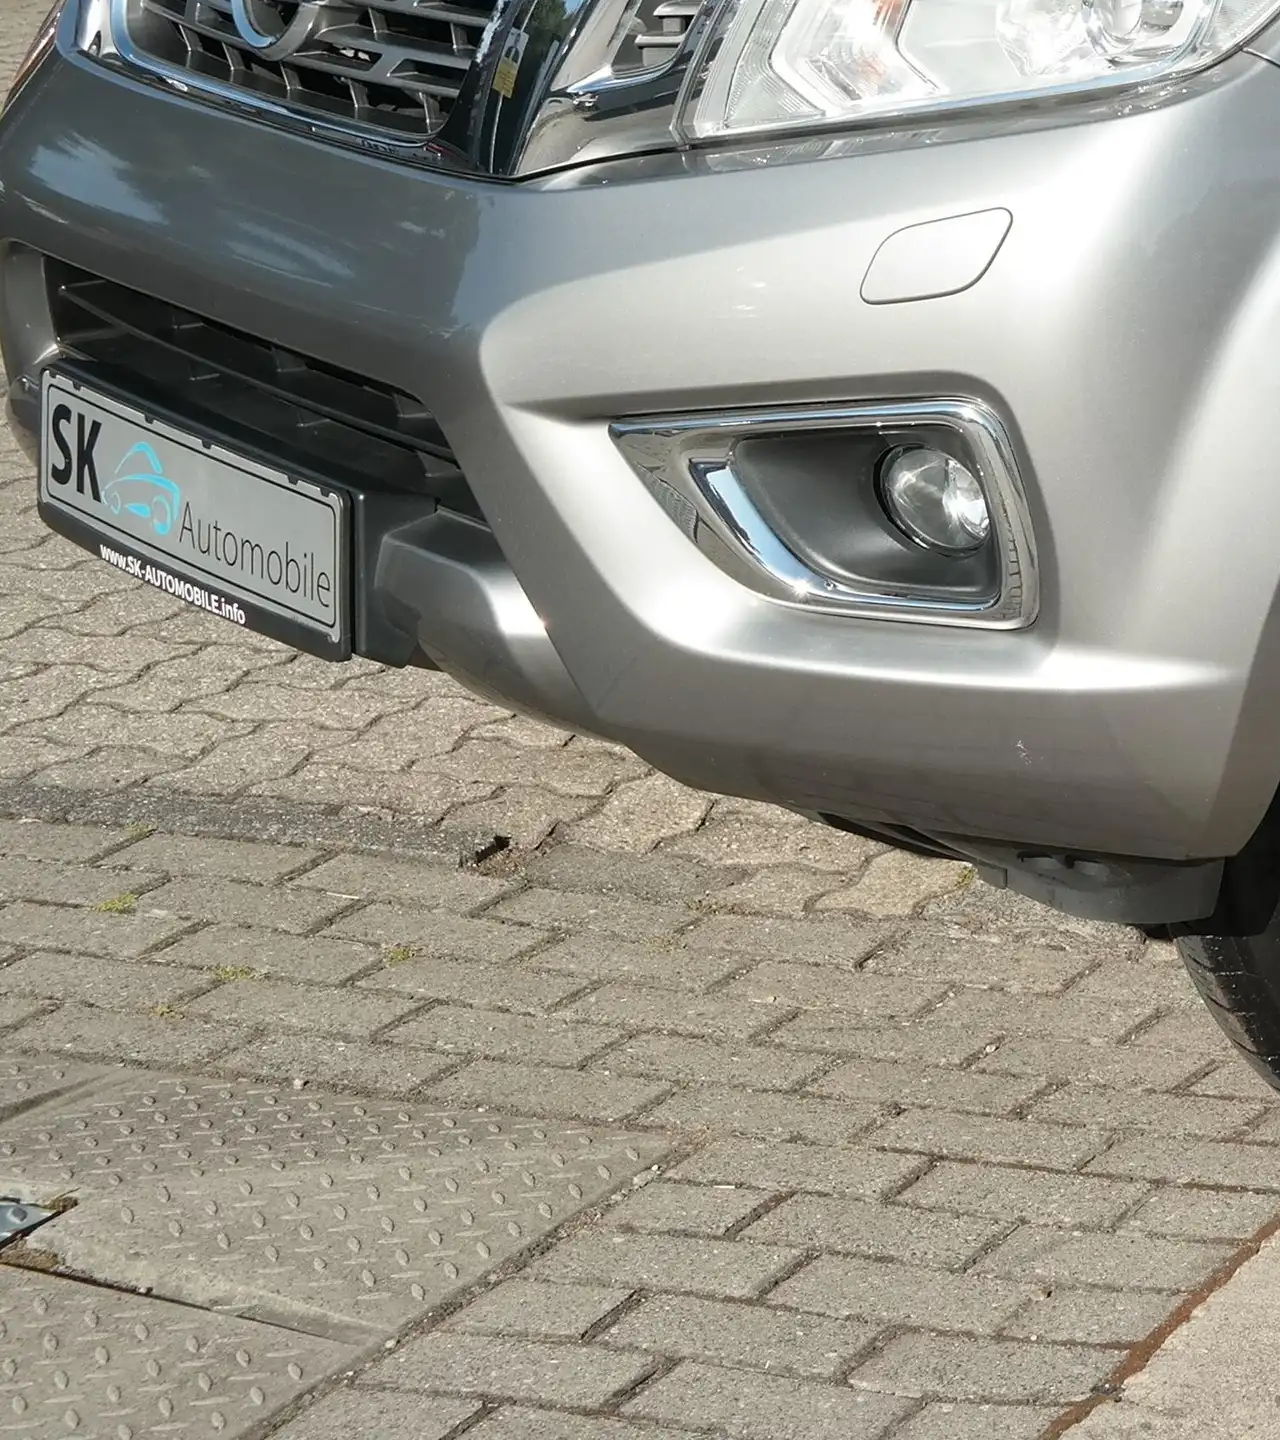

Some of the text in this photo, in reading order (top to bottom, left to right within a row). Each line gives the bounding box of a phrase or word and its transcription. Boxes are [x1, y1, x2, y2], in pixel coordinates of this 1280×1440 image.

[51, 403, 332, 608] SK Automobile
[99, 543, 247, 625] www.SK-AUTOMOBILE.info
